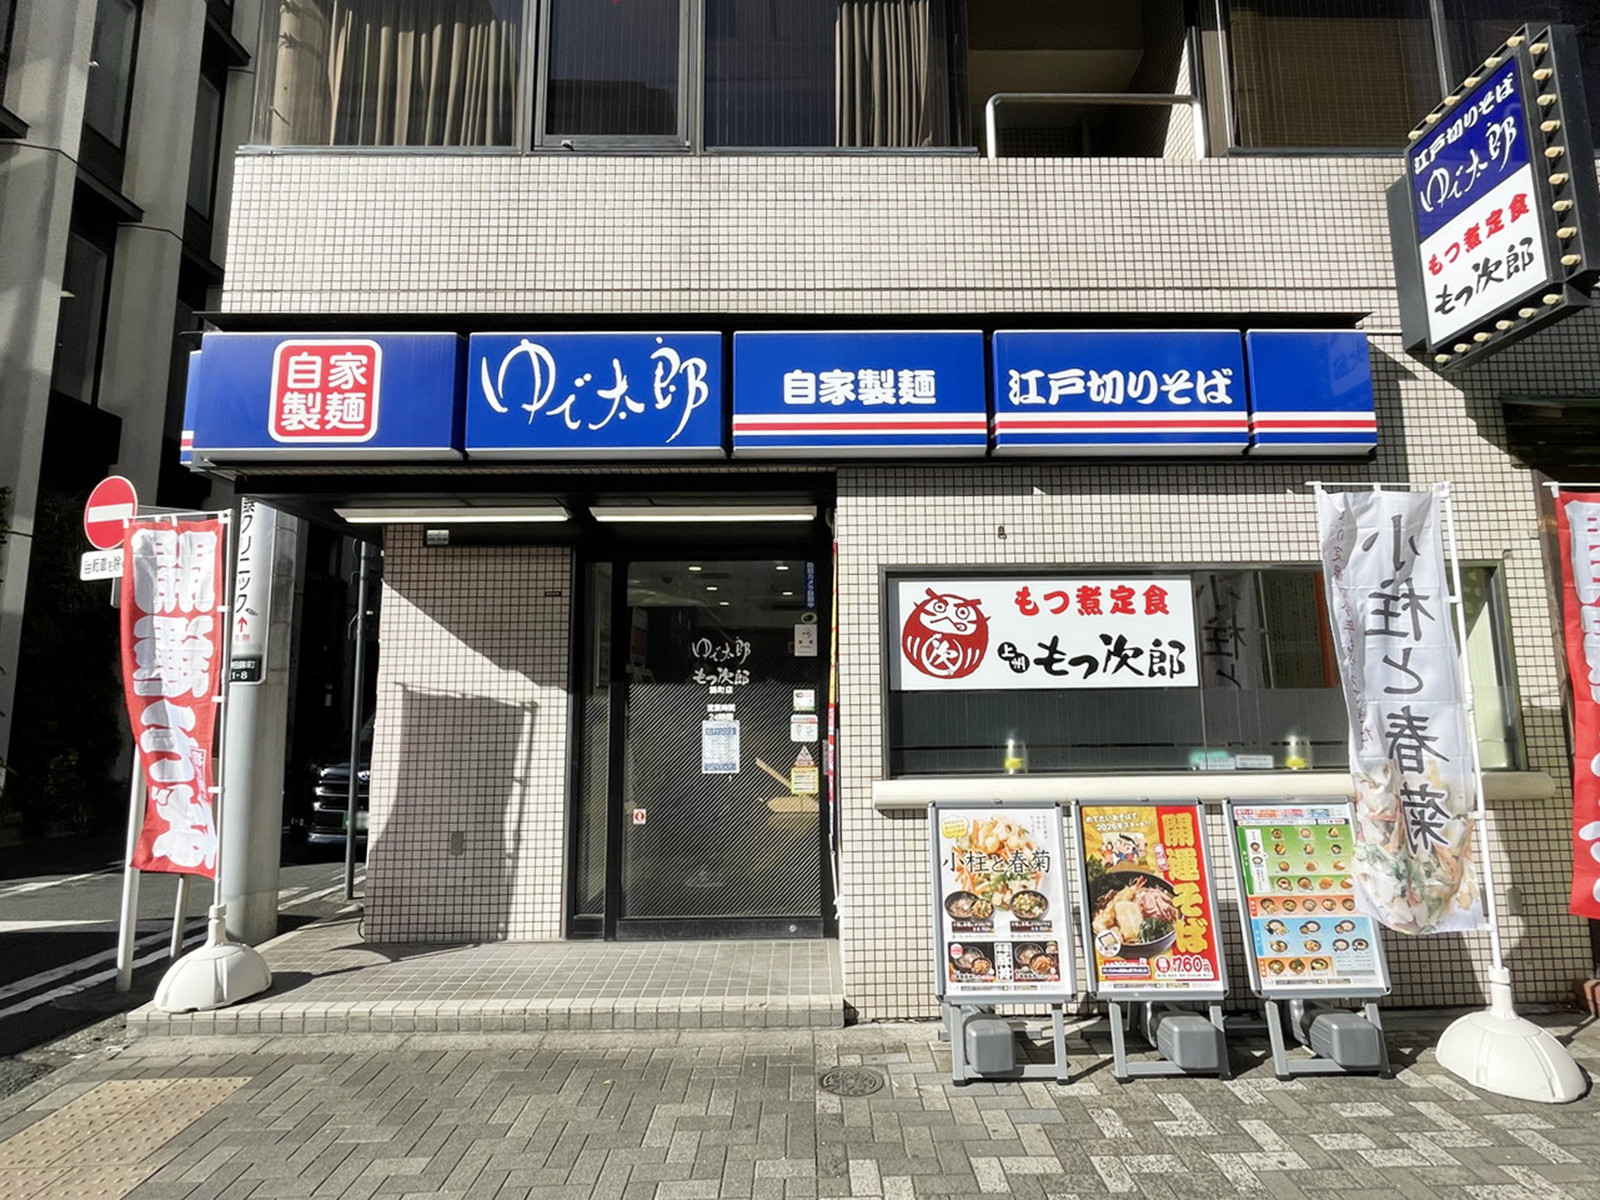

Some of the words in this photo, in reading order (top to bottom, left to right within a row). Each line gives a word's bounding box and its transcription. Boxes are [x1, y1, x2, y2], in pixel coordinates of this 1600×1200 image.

[1414, 72, 1515, 175] 江戸切りそば
[1420, 115, 1517, 212] ゆで太郎
[1428, 192, 1530, 276] もつ煮定食
[1435, 236, 1535, 315] もつ次郎
[481, 337, 710, 443] ゆで太郎
[782, 369, 937, 406] 自家製麺
[1008, 368, 1233, 406] 江戸切りそば
[1014, 584, 1170, 616] もつ煮定食
[692, 636, 751, 665] ゆで太郎
[1033, 633, 1186, 679] もつ次郎
[231, 671, 248, 680] 1-8
[693, 667, 750, 685] もつ次郎
[943, 848, 1051, 874] 小柱と春菊
